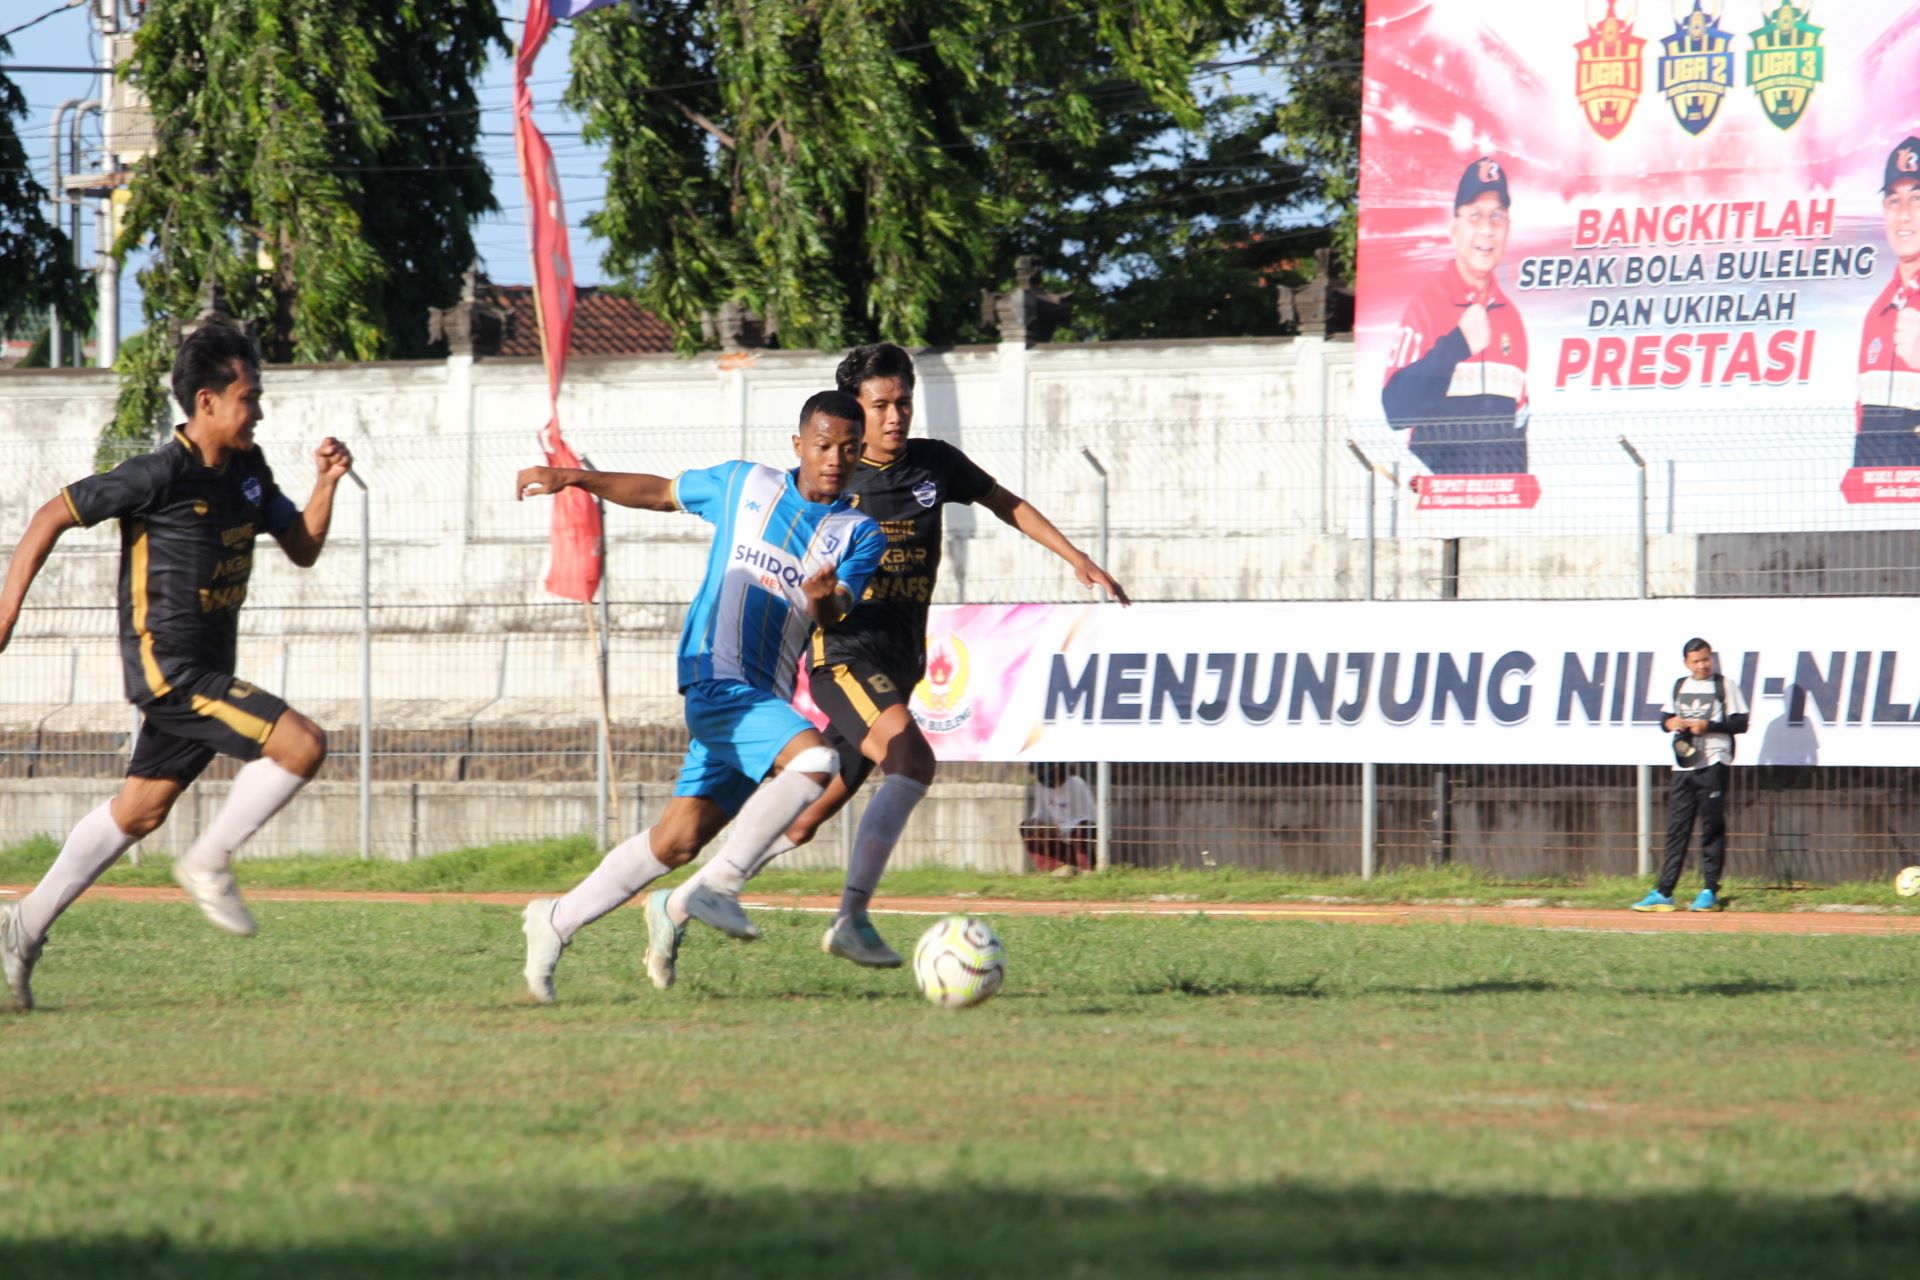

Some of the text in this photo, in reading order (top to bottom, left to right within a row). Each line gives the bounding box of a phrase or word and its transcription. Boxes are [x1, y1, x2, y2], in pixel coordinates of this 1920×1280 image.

[1580, 59, 1639, 92] LIGA 1
[1663, 55, 1728, 88] LIGA 2
[1752, 52, 1797, 87] LIGA
[1800, 51, 1817, 79] 3
[1574, 198, 1836, 248] BANGKITLAH
[1518, 245, 1876, 288] SEPAK BOLA BULELENG
[1587, 291, 1797, 328] DAN UKIRLAH
[1553, 328, 1817, 390] PRESTASI
[1044, 650, 1920, 725] MENJUNJUNG NILI-NIL
